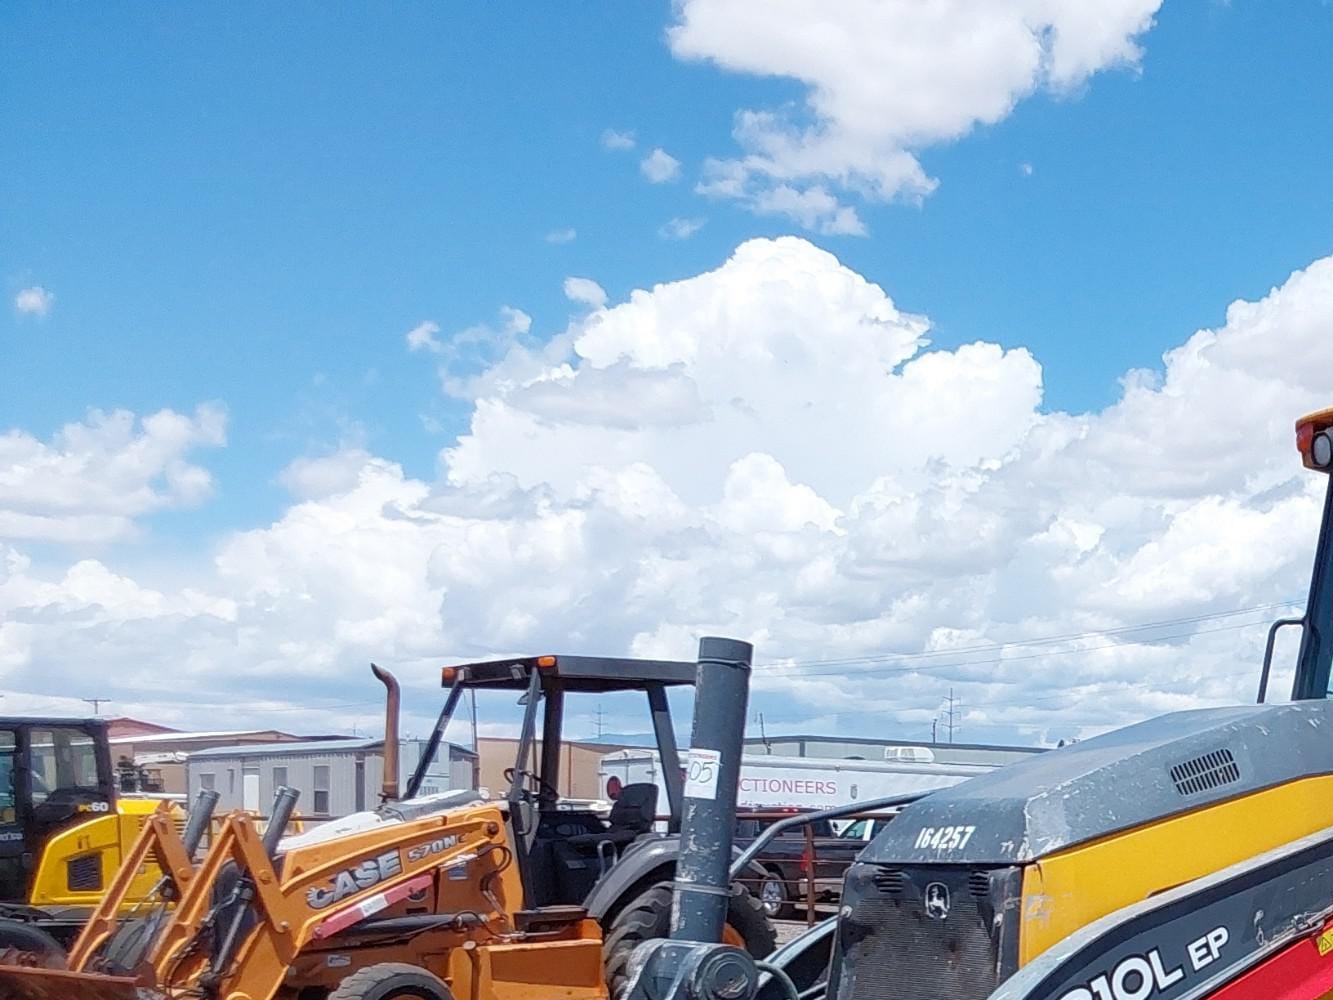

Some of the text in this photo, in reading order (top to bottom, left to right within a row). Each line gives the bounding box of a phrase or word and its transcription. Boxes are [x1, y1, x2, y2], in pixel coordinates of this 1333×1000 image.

[79, 801, 109, 812] PC60
[914, 825, 977, 849] 164257
[306, 849, 402, 909] CASE
[1187, 926, 1229, 971] EP
